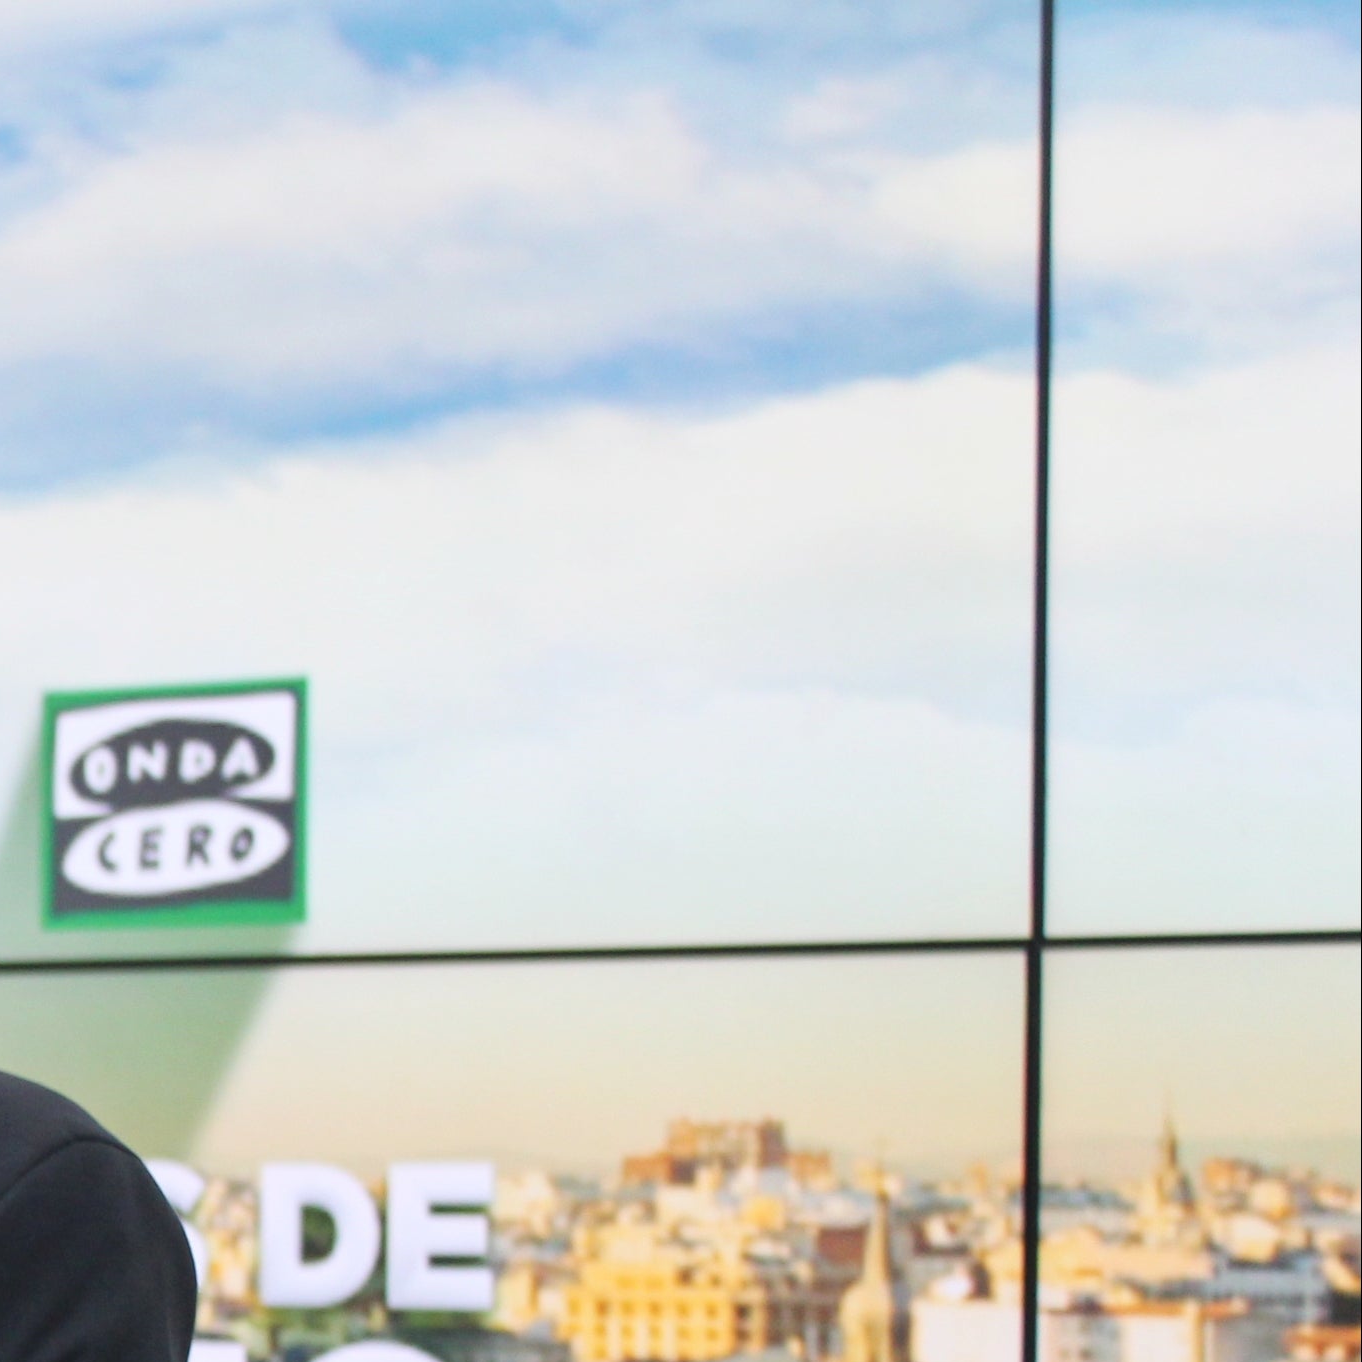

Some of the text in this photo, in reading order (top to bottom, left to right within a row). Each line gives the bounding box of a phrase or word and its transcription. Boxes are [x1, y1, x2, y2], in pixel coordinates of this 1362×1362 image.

[82, 736, 260, 795] ONDA
[97, 823, 255, 874] CERO
[259, 1160, 495, 1311] DE
